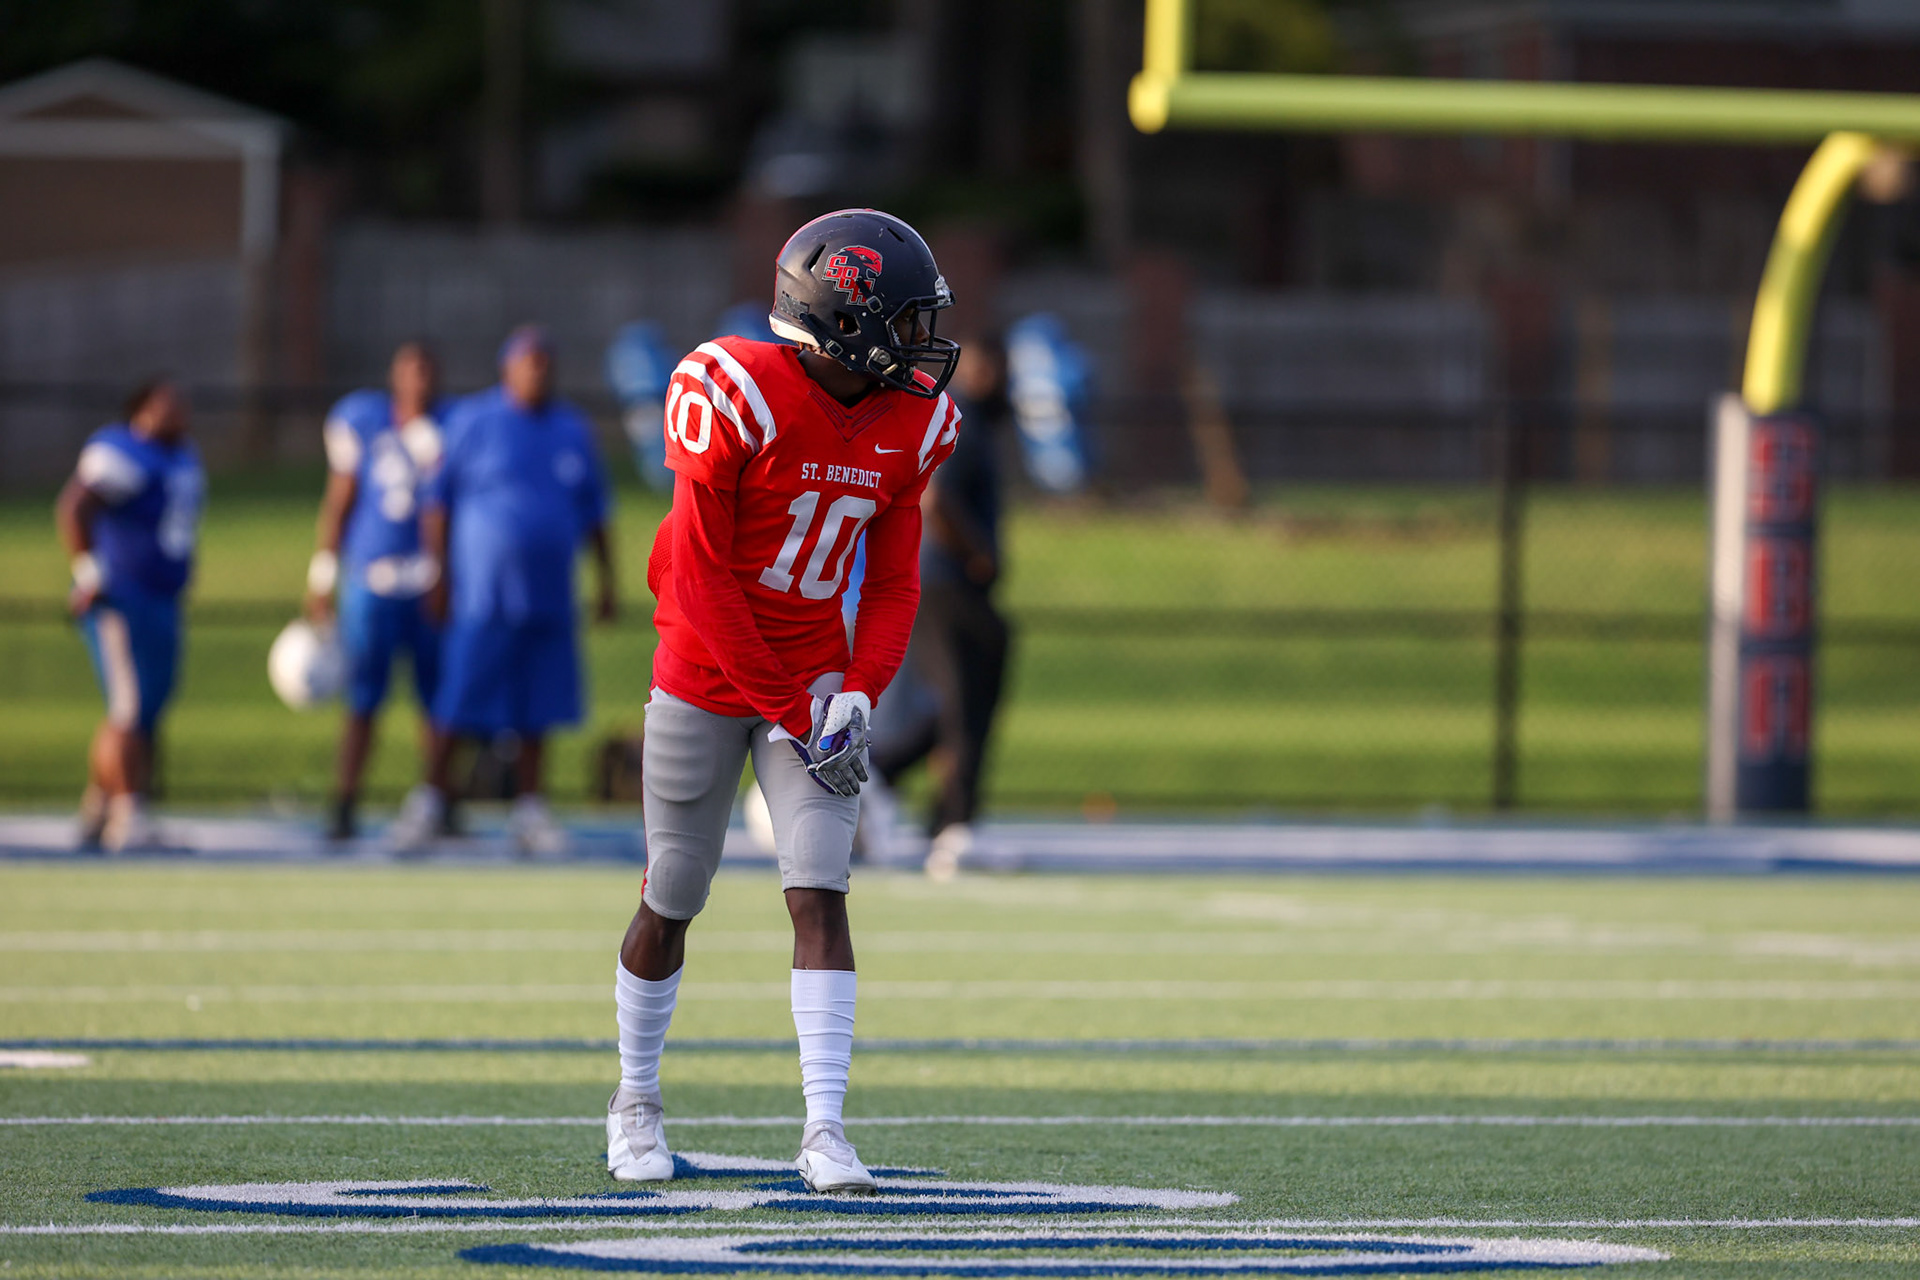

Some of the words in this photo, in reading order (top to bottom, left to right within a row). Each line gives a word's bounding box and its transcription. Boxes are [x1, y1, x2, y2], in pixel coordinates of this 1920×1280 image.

[666, 381, 712, 454] 10
[801, 462, 821, 480] ST.
[825, 464, 882, 488] BENEDICT
[758, 490, 876, 599] 10
